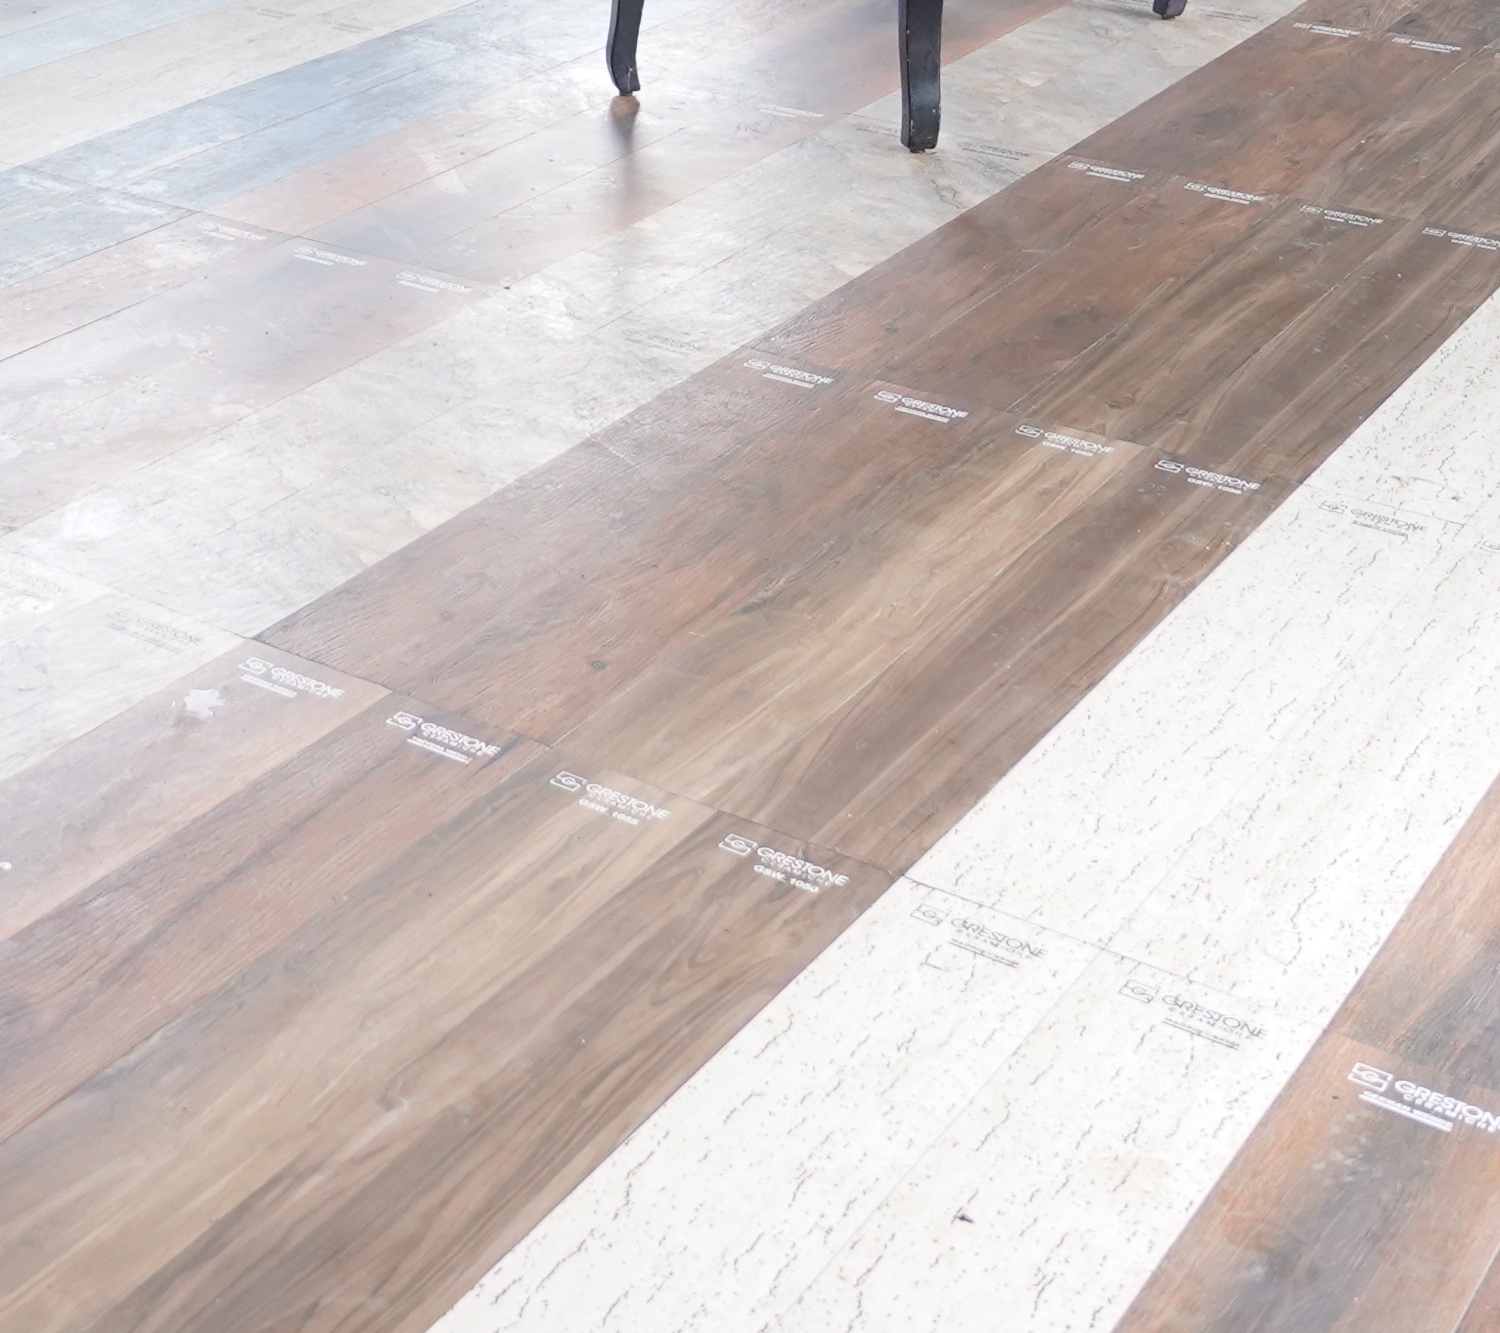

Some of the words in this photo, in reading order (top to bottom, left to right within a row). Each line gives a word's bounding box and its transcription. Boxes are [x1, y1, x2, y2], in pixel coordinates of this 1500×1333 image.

[586, 783, 671, 821] GRESTONE
[757, 846, 850, 887] GRESTONE
[951, 917, 1050, 960] GRESTONE
[1162, 994, 1270, 1039] GRESTONE
